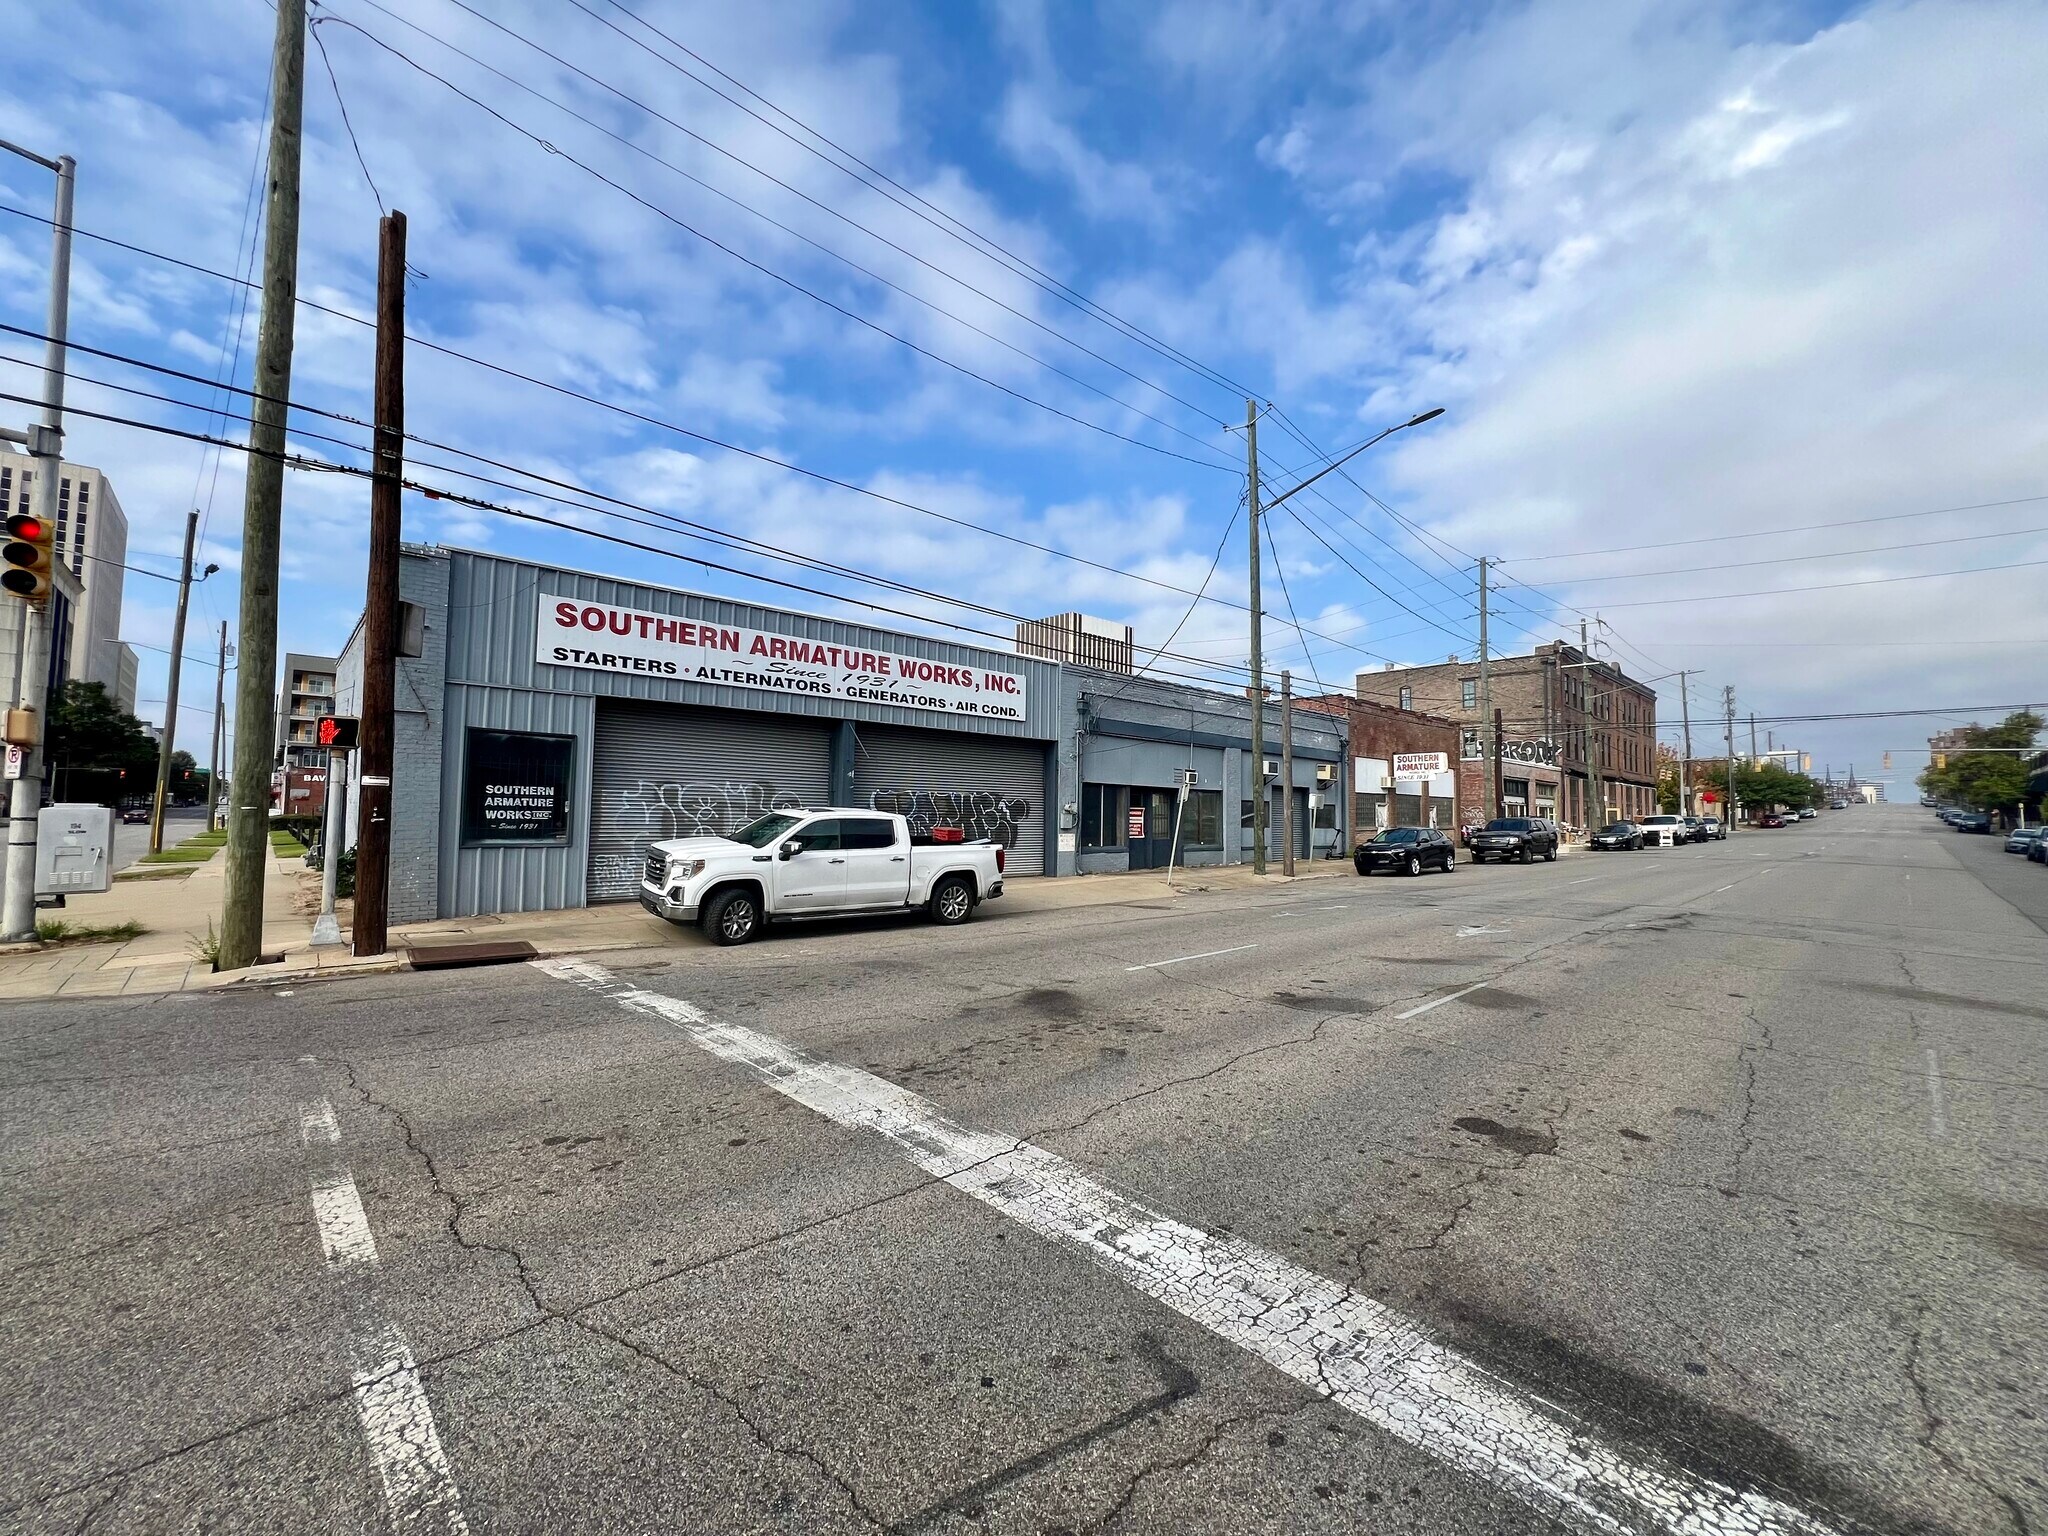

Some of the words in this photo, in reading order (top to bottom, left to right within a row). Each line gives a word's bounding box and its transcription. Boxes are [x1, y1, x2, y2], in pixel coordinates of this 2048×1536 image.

[555, 602, 740, 652] SOUTHERN
[749, 635, 891, 675] ARMATURE
[898, 659, 980, 693] WORKS,
[984, 673, 1021, 695] INC.
[765, 661, 828, 680] Since
[842, 672, 899, 689] 1931
[553, 647, 677, 675] STARTERS
[696, 666, 832, 694] ALTERNATORS
[846, 686, 947, 709] GENERATORS
[955, 701, 978, 713] AIR
[981, 704, 1020, 718] COND.
[1397, 754, 1439, 763] SOUTHERN
[1397, 763, 1439, 771] ARMATURE
[485, 784, 555, 796] SOUTHERN
[484, 797, 554, 807] ARMATURE
[485, 810, 532, 820] WORKS
[532, 811, 552, 819] INC.
